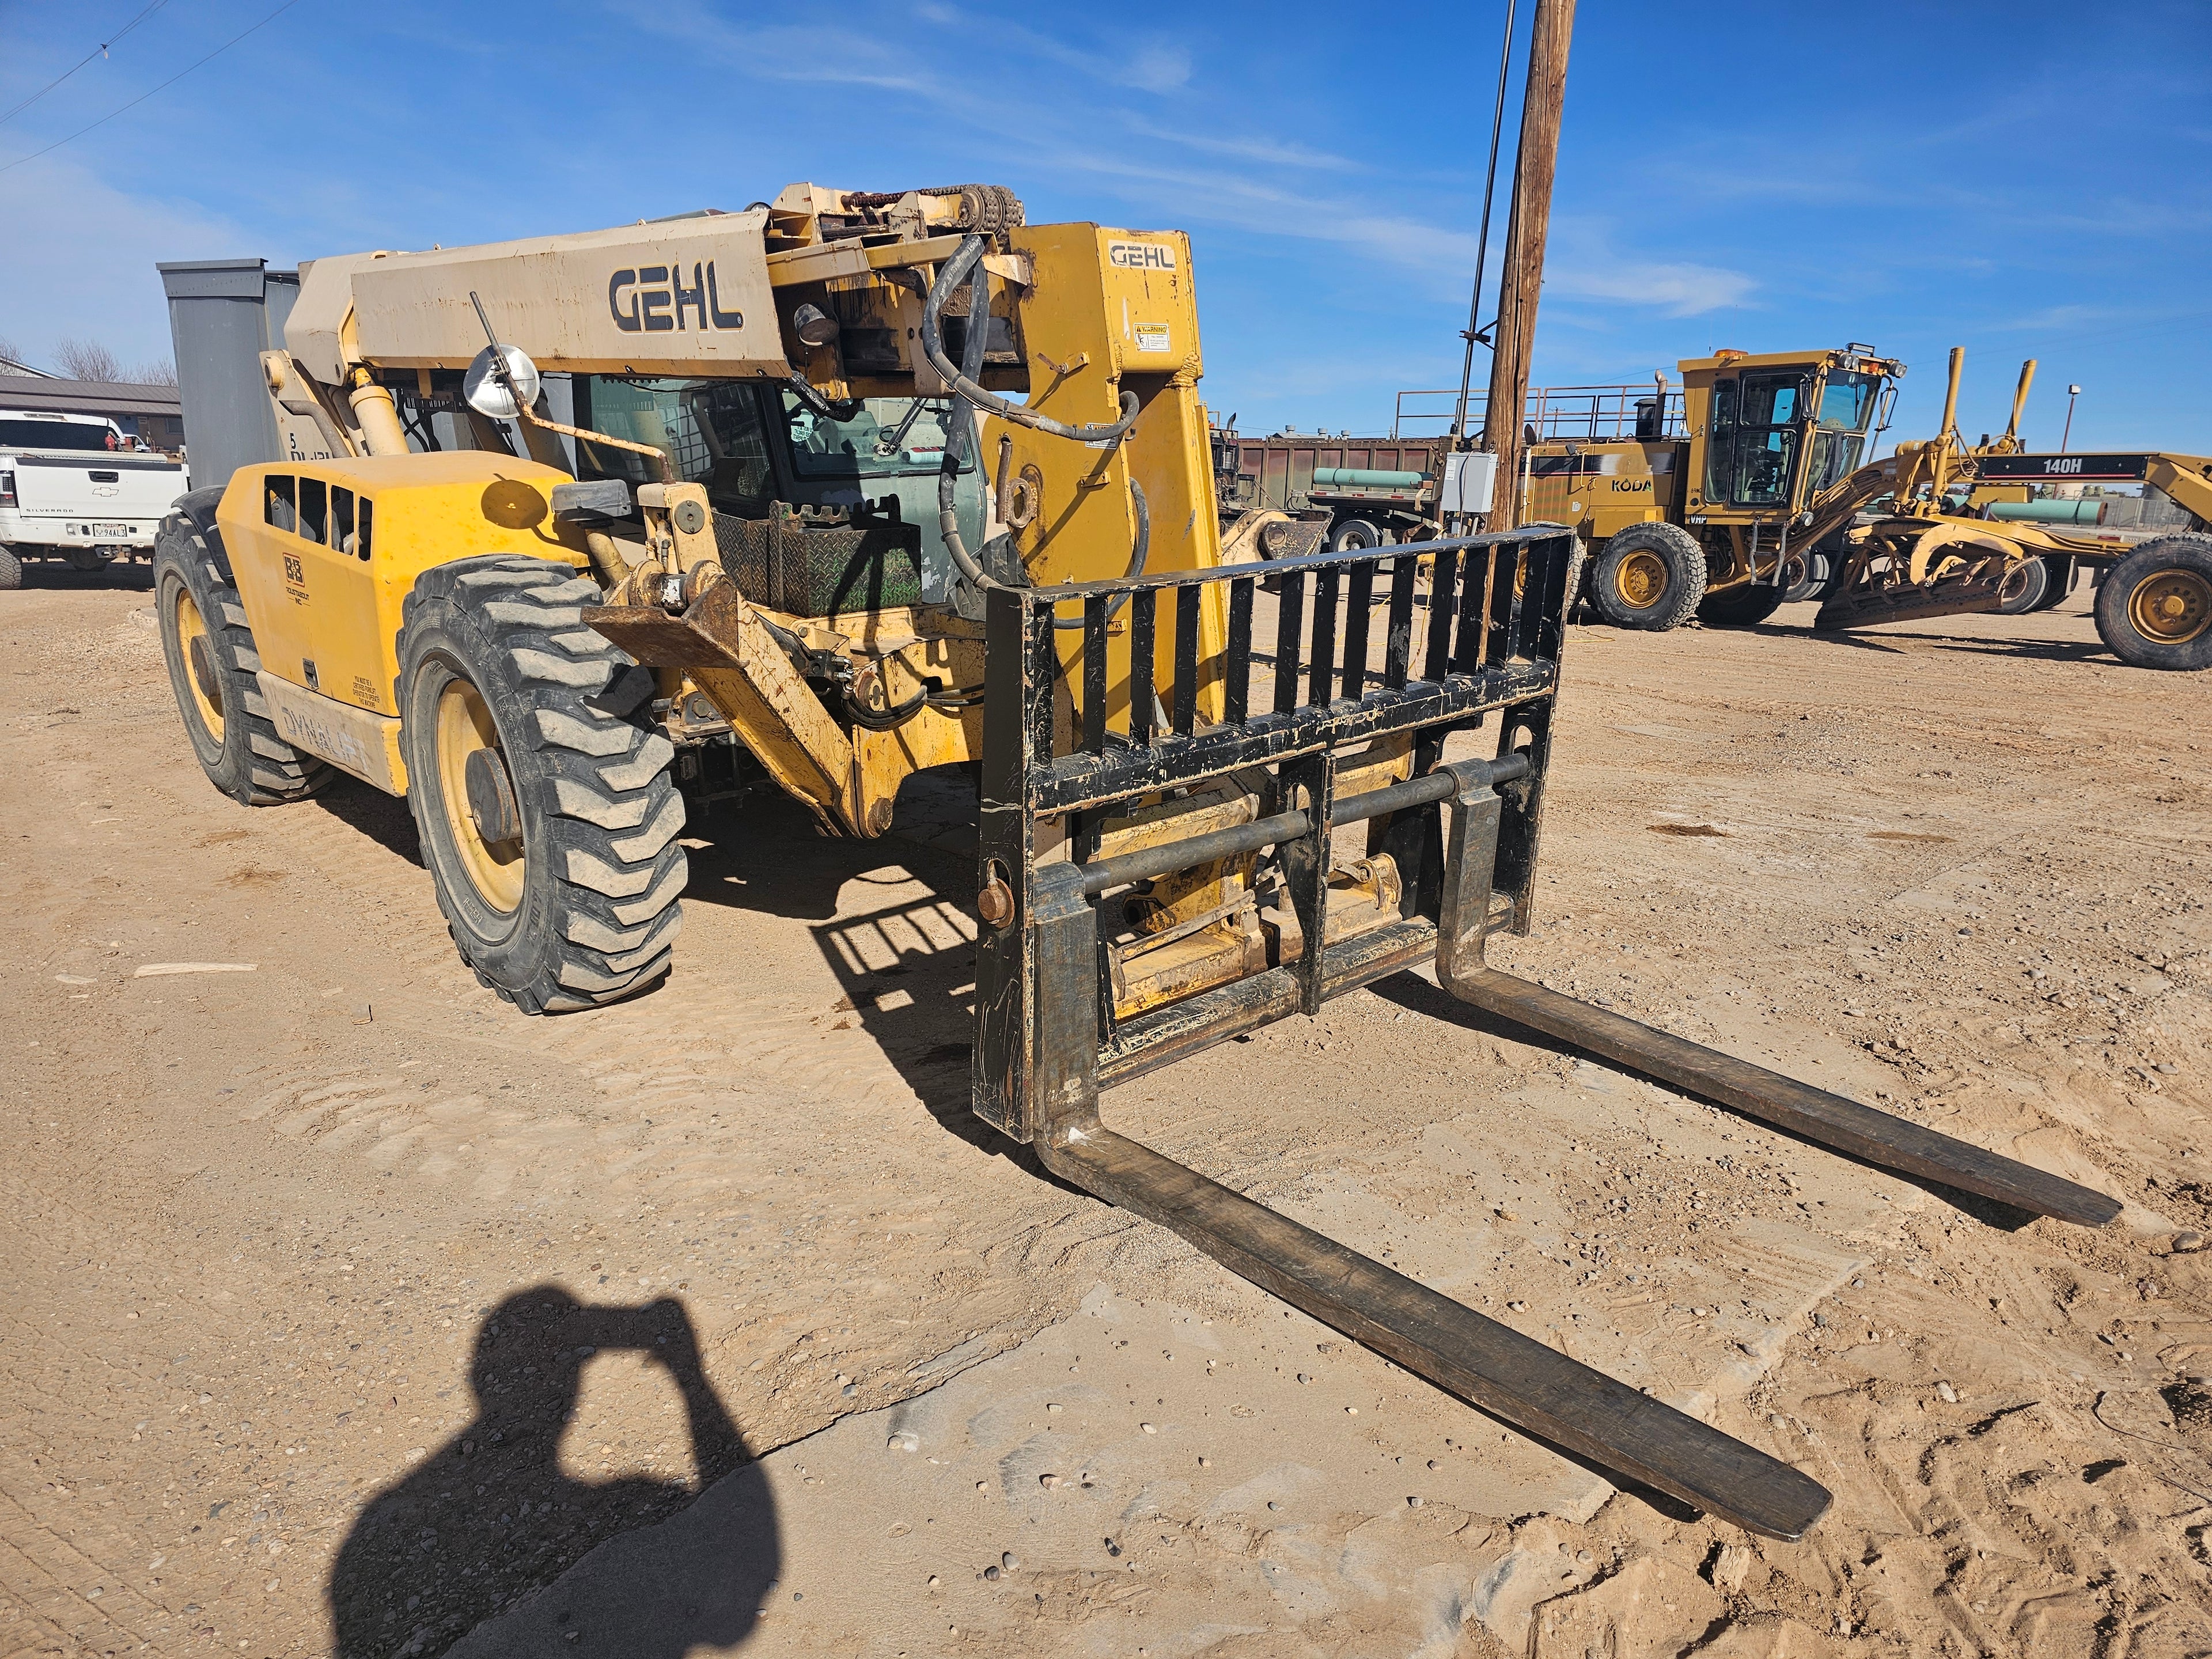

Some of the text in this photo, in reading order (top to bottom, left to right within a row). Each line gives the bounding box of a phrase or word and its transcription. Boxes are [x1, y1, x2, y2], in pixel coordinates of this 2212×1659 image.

[1111, 245, 1175, 268] GEHL
[608, 260, 744, 333] GEHL
[290, 433, 296, 449] 5
[2044, 459, 2082, 474] 140H
[1612, 479, 1652, 492] KODA
[1691, 515, 1707, 524] VHP
